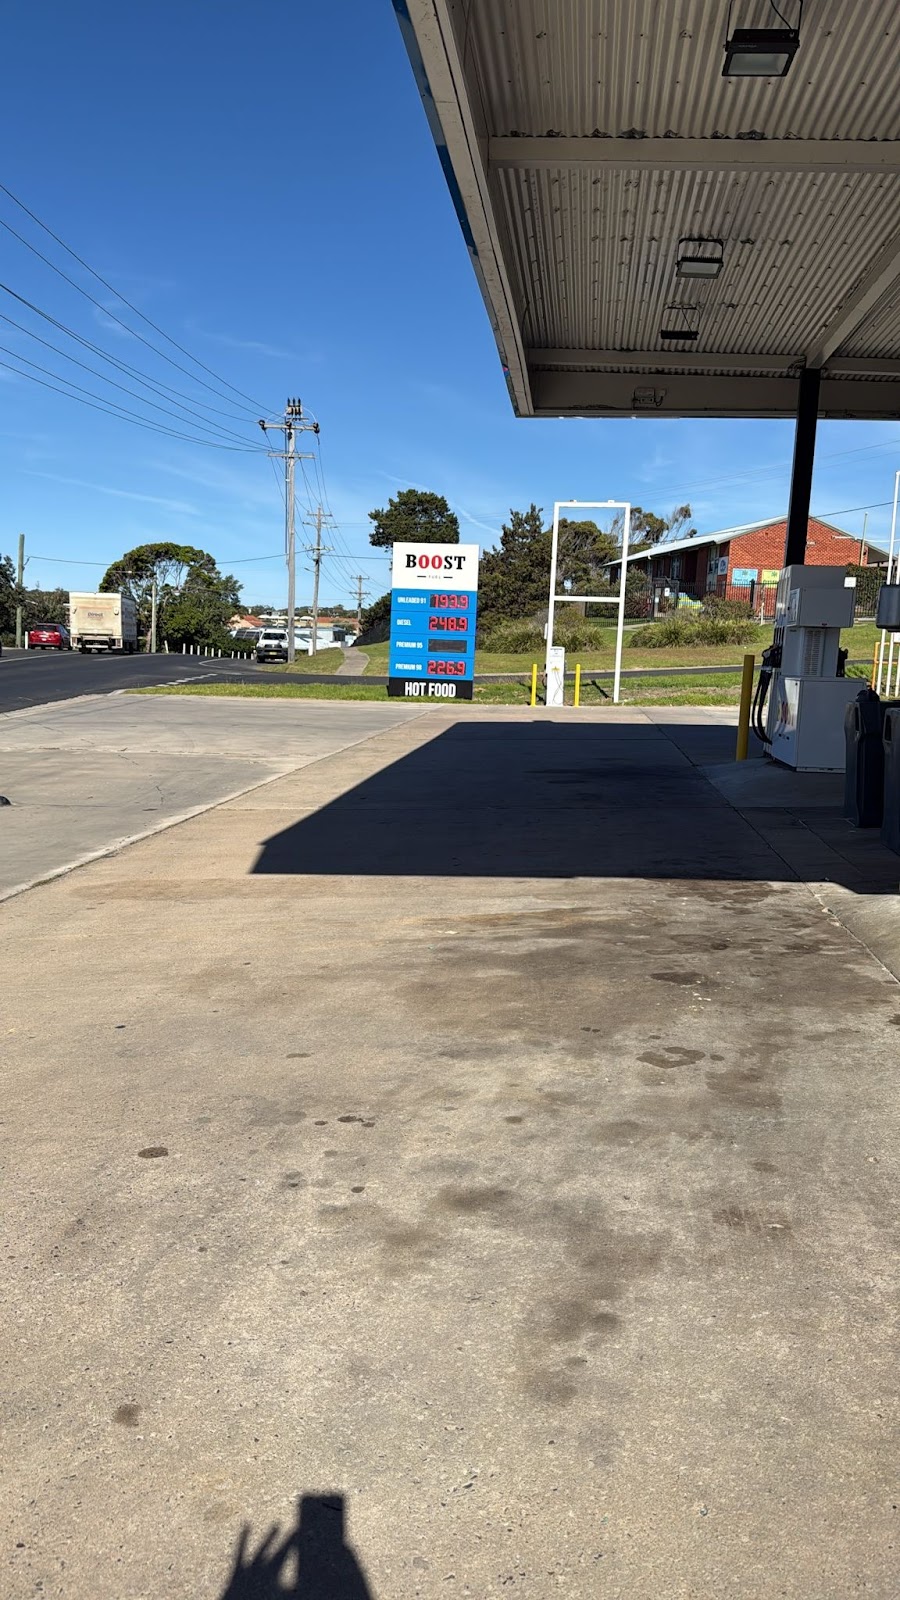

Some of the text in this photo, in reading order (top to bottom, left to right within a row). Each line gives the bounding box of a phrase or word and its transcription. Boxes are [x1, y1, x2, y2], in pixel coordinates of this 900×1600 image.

[405, 554, 466, 570] BOOST
[434, 594, 468, 609] 193.9
[430, 616, 467, 632] 248.9
[428, 660, 465, 675] 226.9
[405, 682, 456, 697] HOT FOOD
